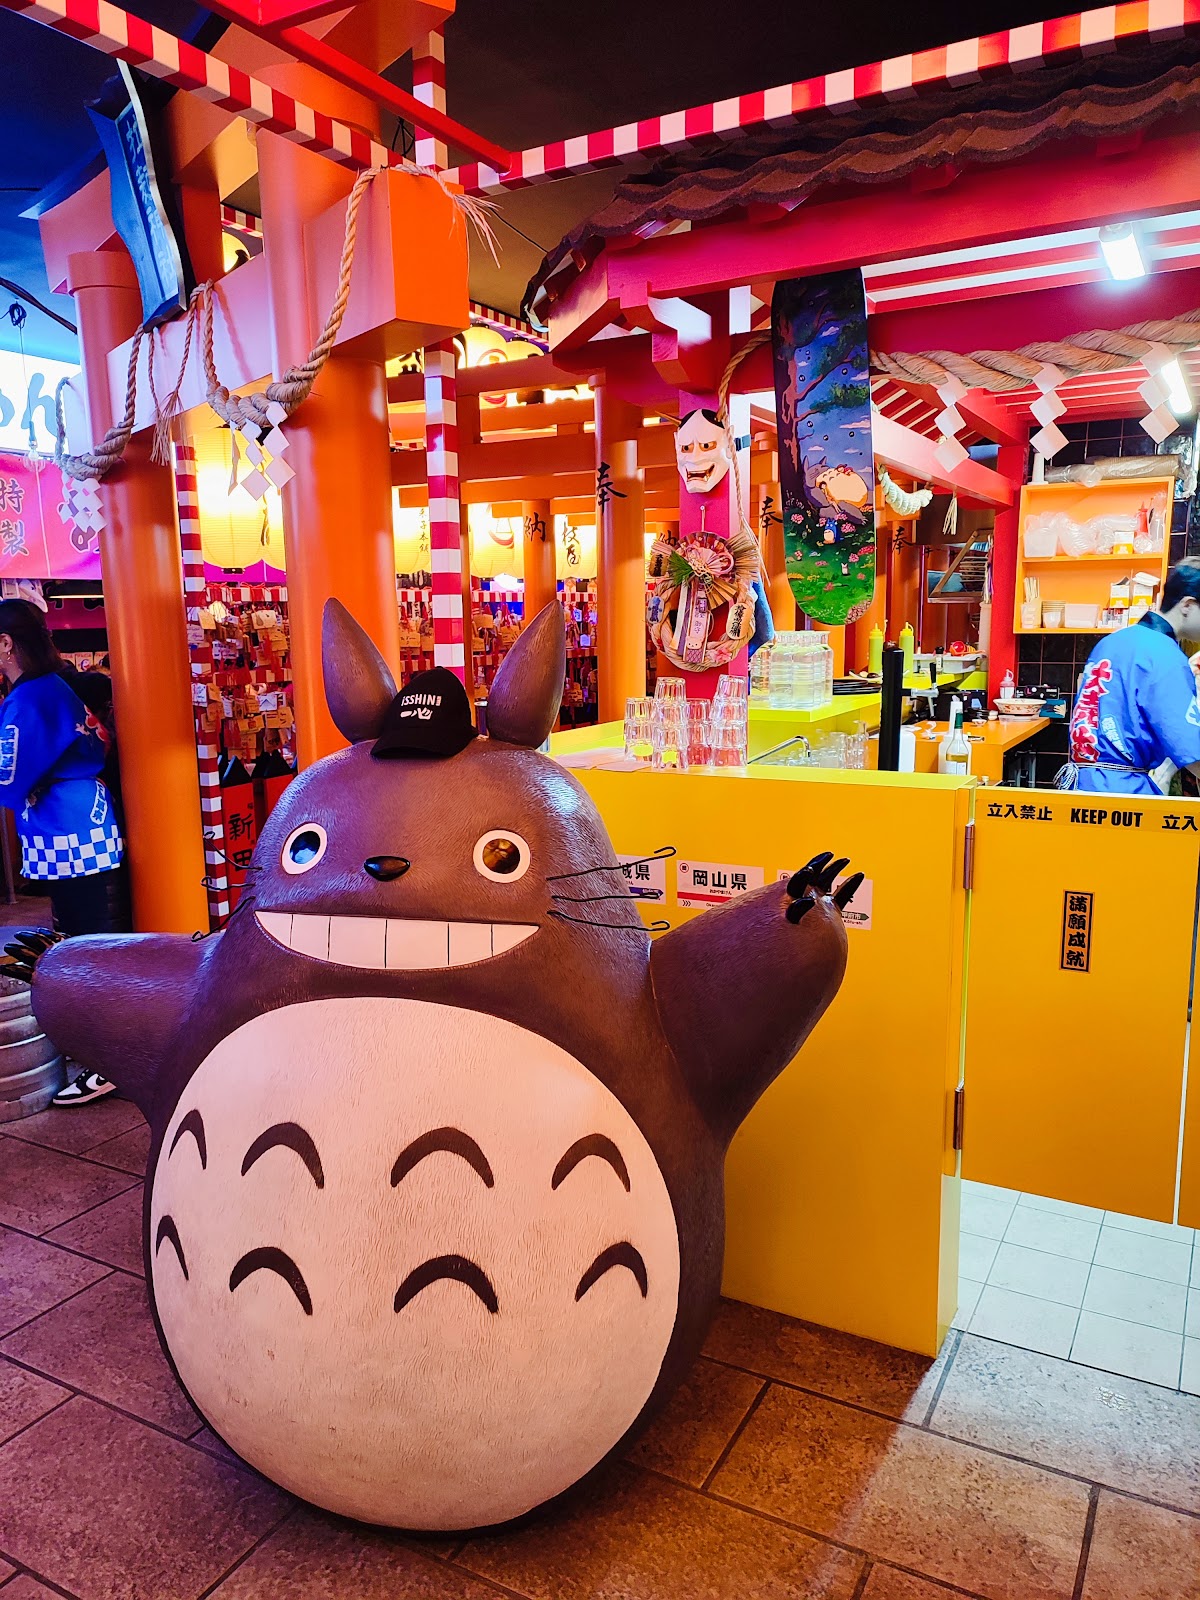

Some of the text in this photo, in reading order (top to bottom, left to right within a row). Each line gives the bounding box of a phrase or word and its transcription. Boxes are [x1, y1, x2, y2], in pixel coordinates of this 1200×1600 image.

[597, 461, 628, 515] 奉
[525, 512, 547, 543] 納
[760, 496, 783, 536] 奉
[893, 526, 913, 555] 奉
[400, 707, 433, 720] 一心
[987, 802, 1199, 831] 立入禁止 KEEP OUT 立入
[692, 869, 748, 891] 岡山県
